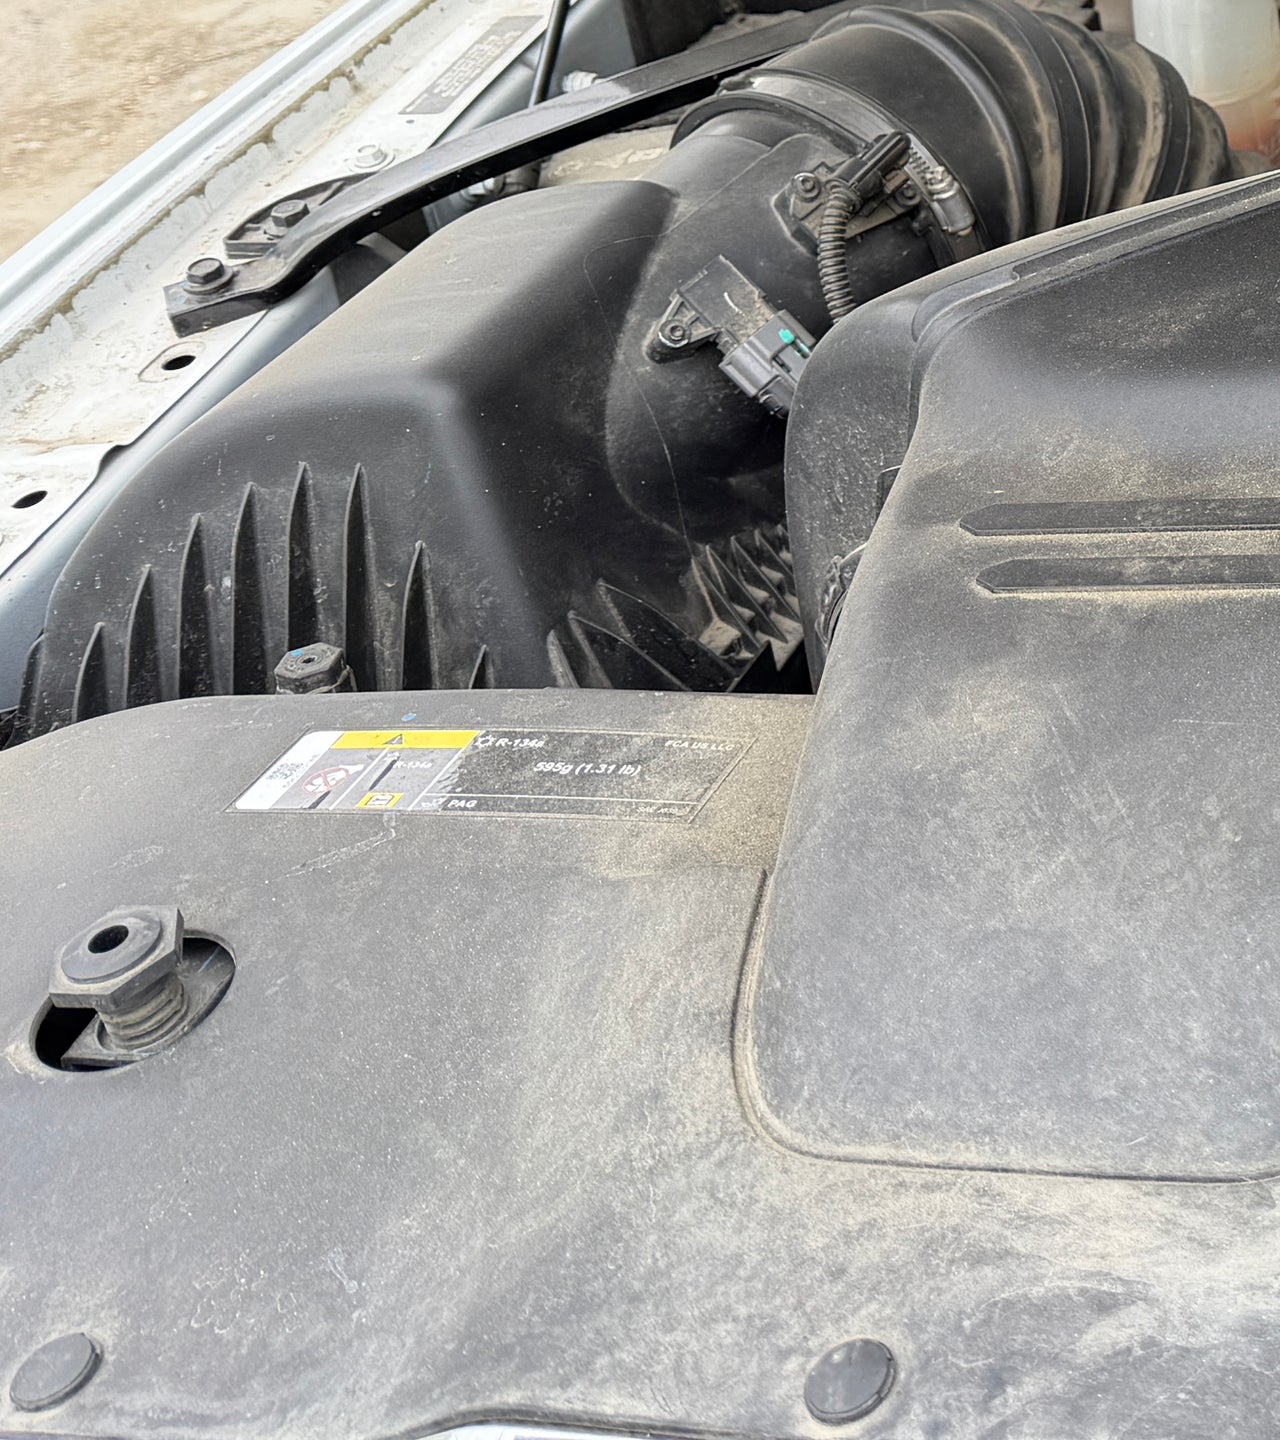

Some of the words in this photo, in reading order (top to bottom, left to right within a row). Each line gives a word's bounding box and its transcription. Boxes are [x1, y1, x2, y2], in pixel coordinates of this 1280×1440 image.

[495, 737, 545, 748] R-134a
[533, 762, 573, 775] 595g
[575, 763, 617, 775] (1.31
[618, 765, 642, 777] lb)
[448, 799, 478, 808] PAG
